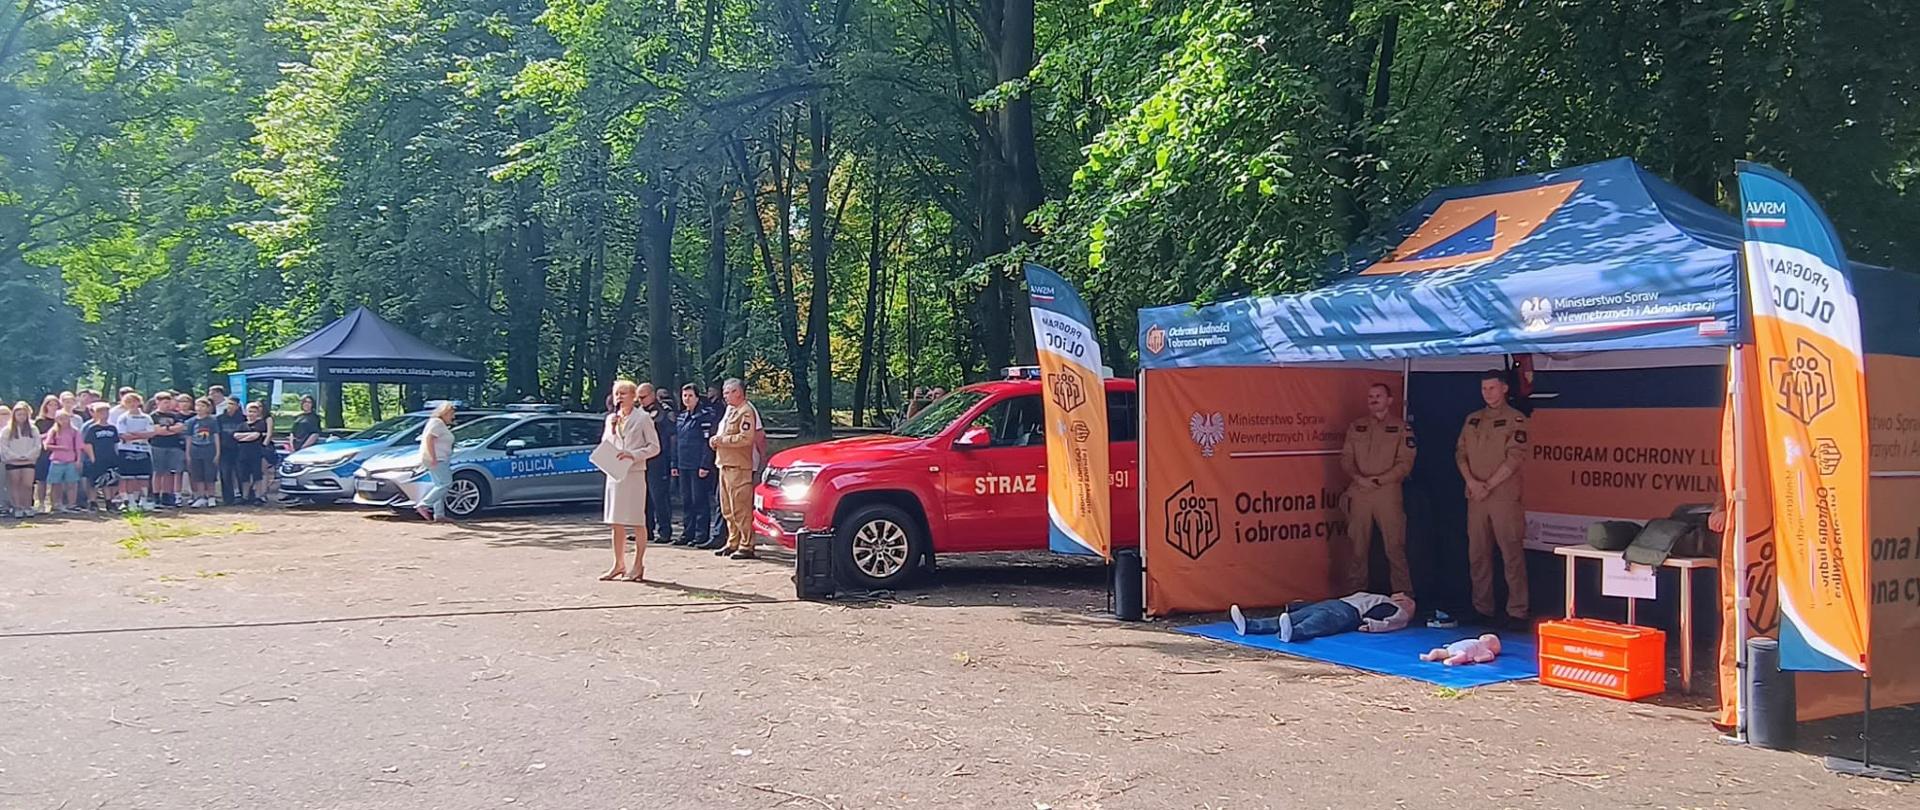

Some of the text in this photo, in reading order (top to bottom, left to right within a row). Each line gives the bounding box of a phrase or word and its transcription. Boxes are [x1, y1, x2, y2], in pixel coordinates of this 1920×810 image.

[1554, 291, 1660, 309] Ministerstwo Spraw
[1641, 300, 1716, 316] Administracji
[1228, 412, 1294, 426] Ministerstwo
[1533, 445, 1608, 462] PROGRAM
[1613, 446, 1696, 465] OCHRONY
[511, 458, 554, 473] POLICJA
[1571, 470, 1575, 486] I
[1580, 470, 1648, 490] OBRONY
[1235, 490, 1316, 514] Ochrona
[1235, 521, 1241, 544] i
[1245, 520, 1311, 543] obrona
